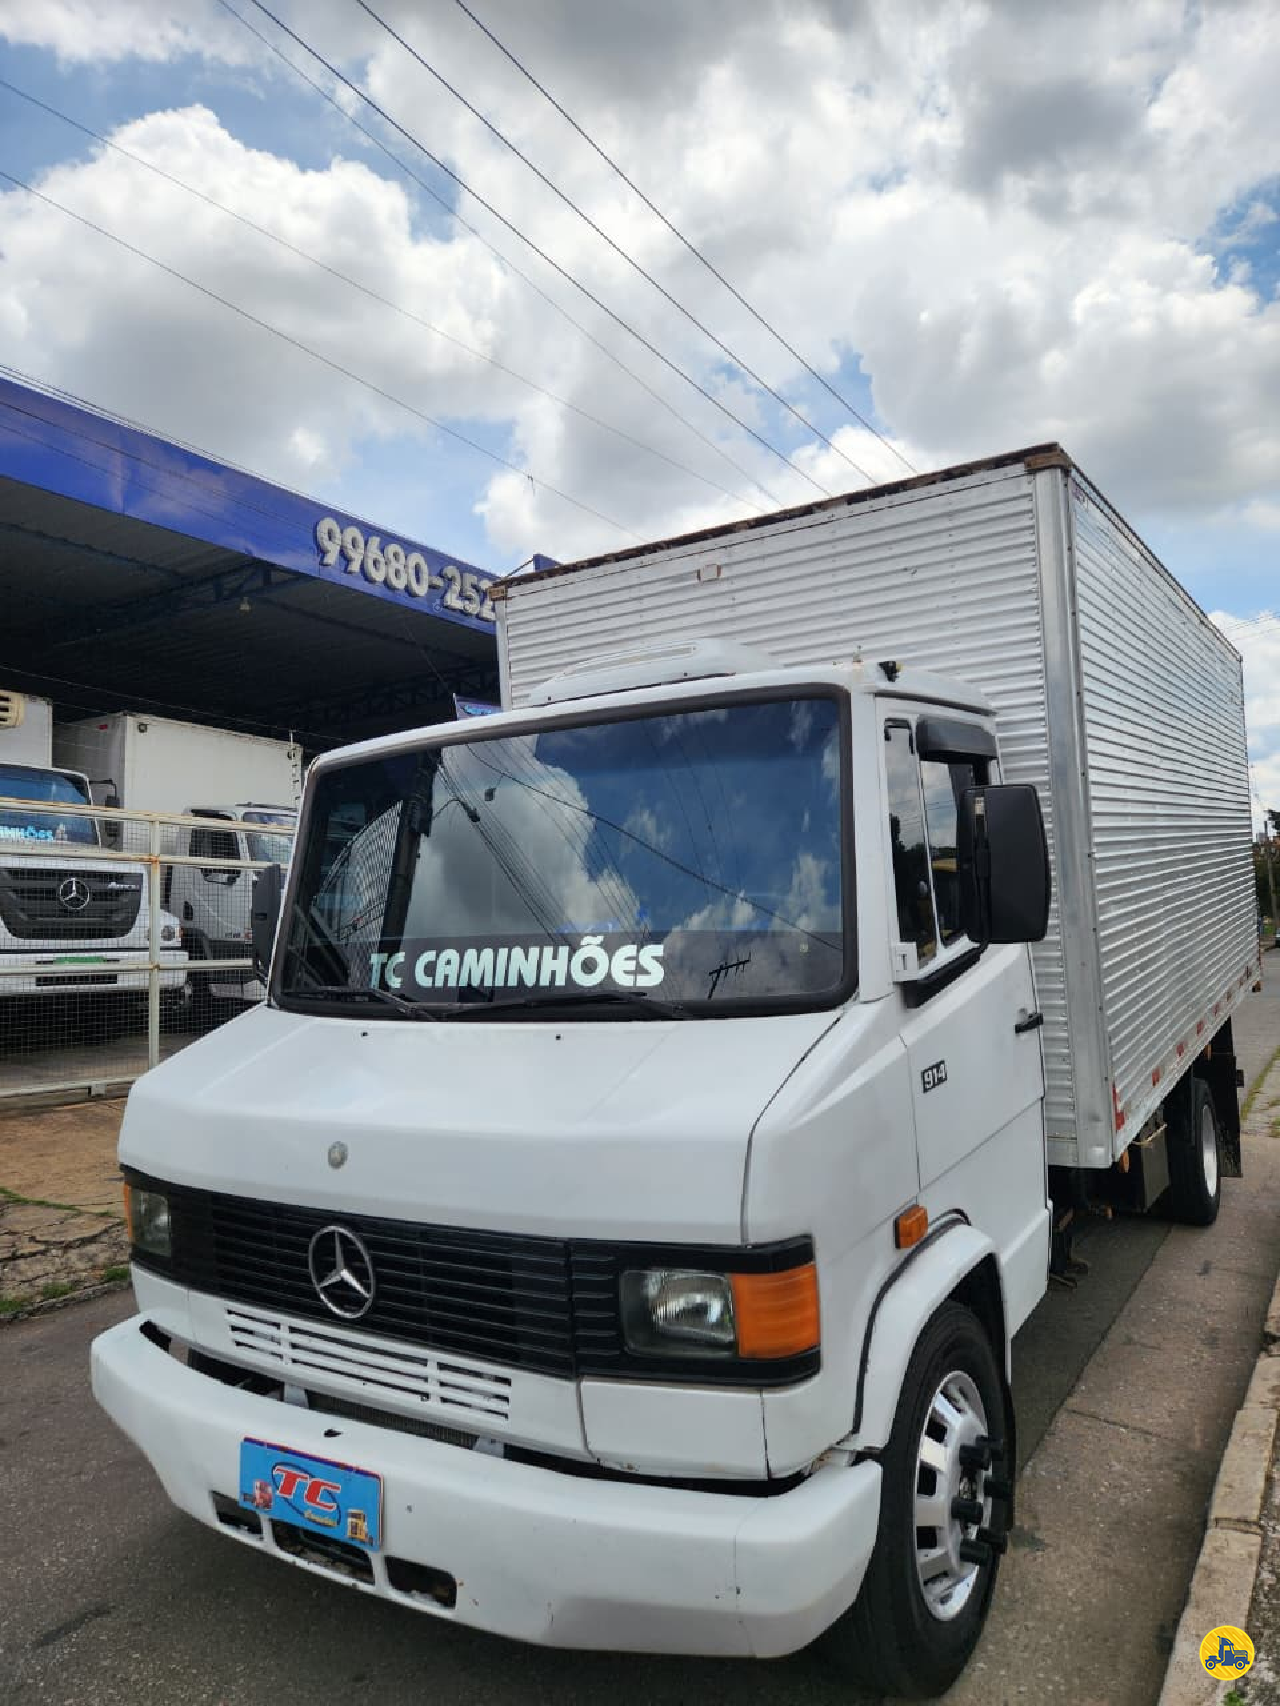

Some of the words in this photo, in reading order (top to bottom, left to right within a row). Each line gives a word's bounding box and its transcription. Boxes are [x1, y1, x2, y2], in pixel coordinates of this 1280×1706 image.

[370, 952, 406, 988] TC
[415, 935, 665, 988] CAMINHÕES
[923, 1063, 946, 1090] 914
[272, 1465, 341, 1511] TC
